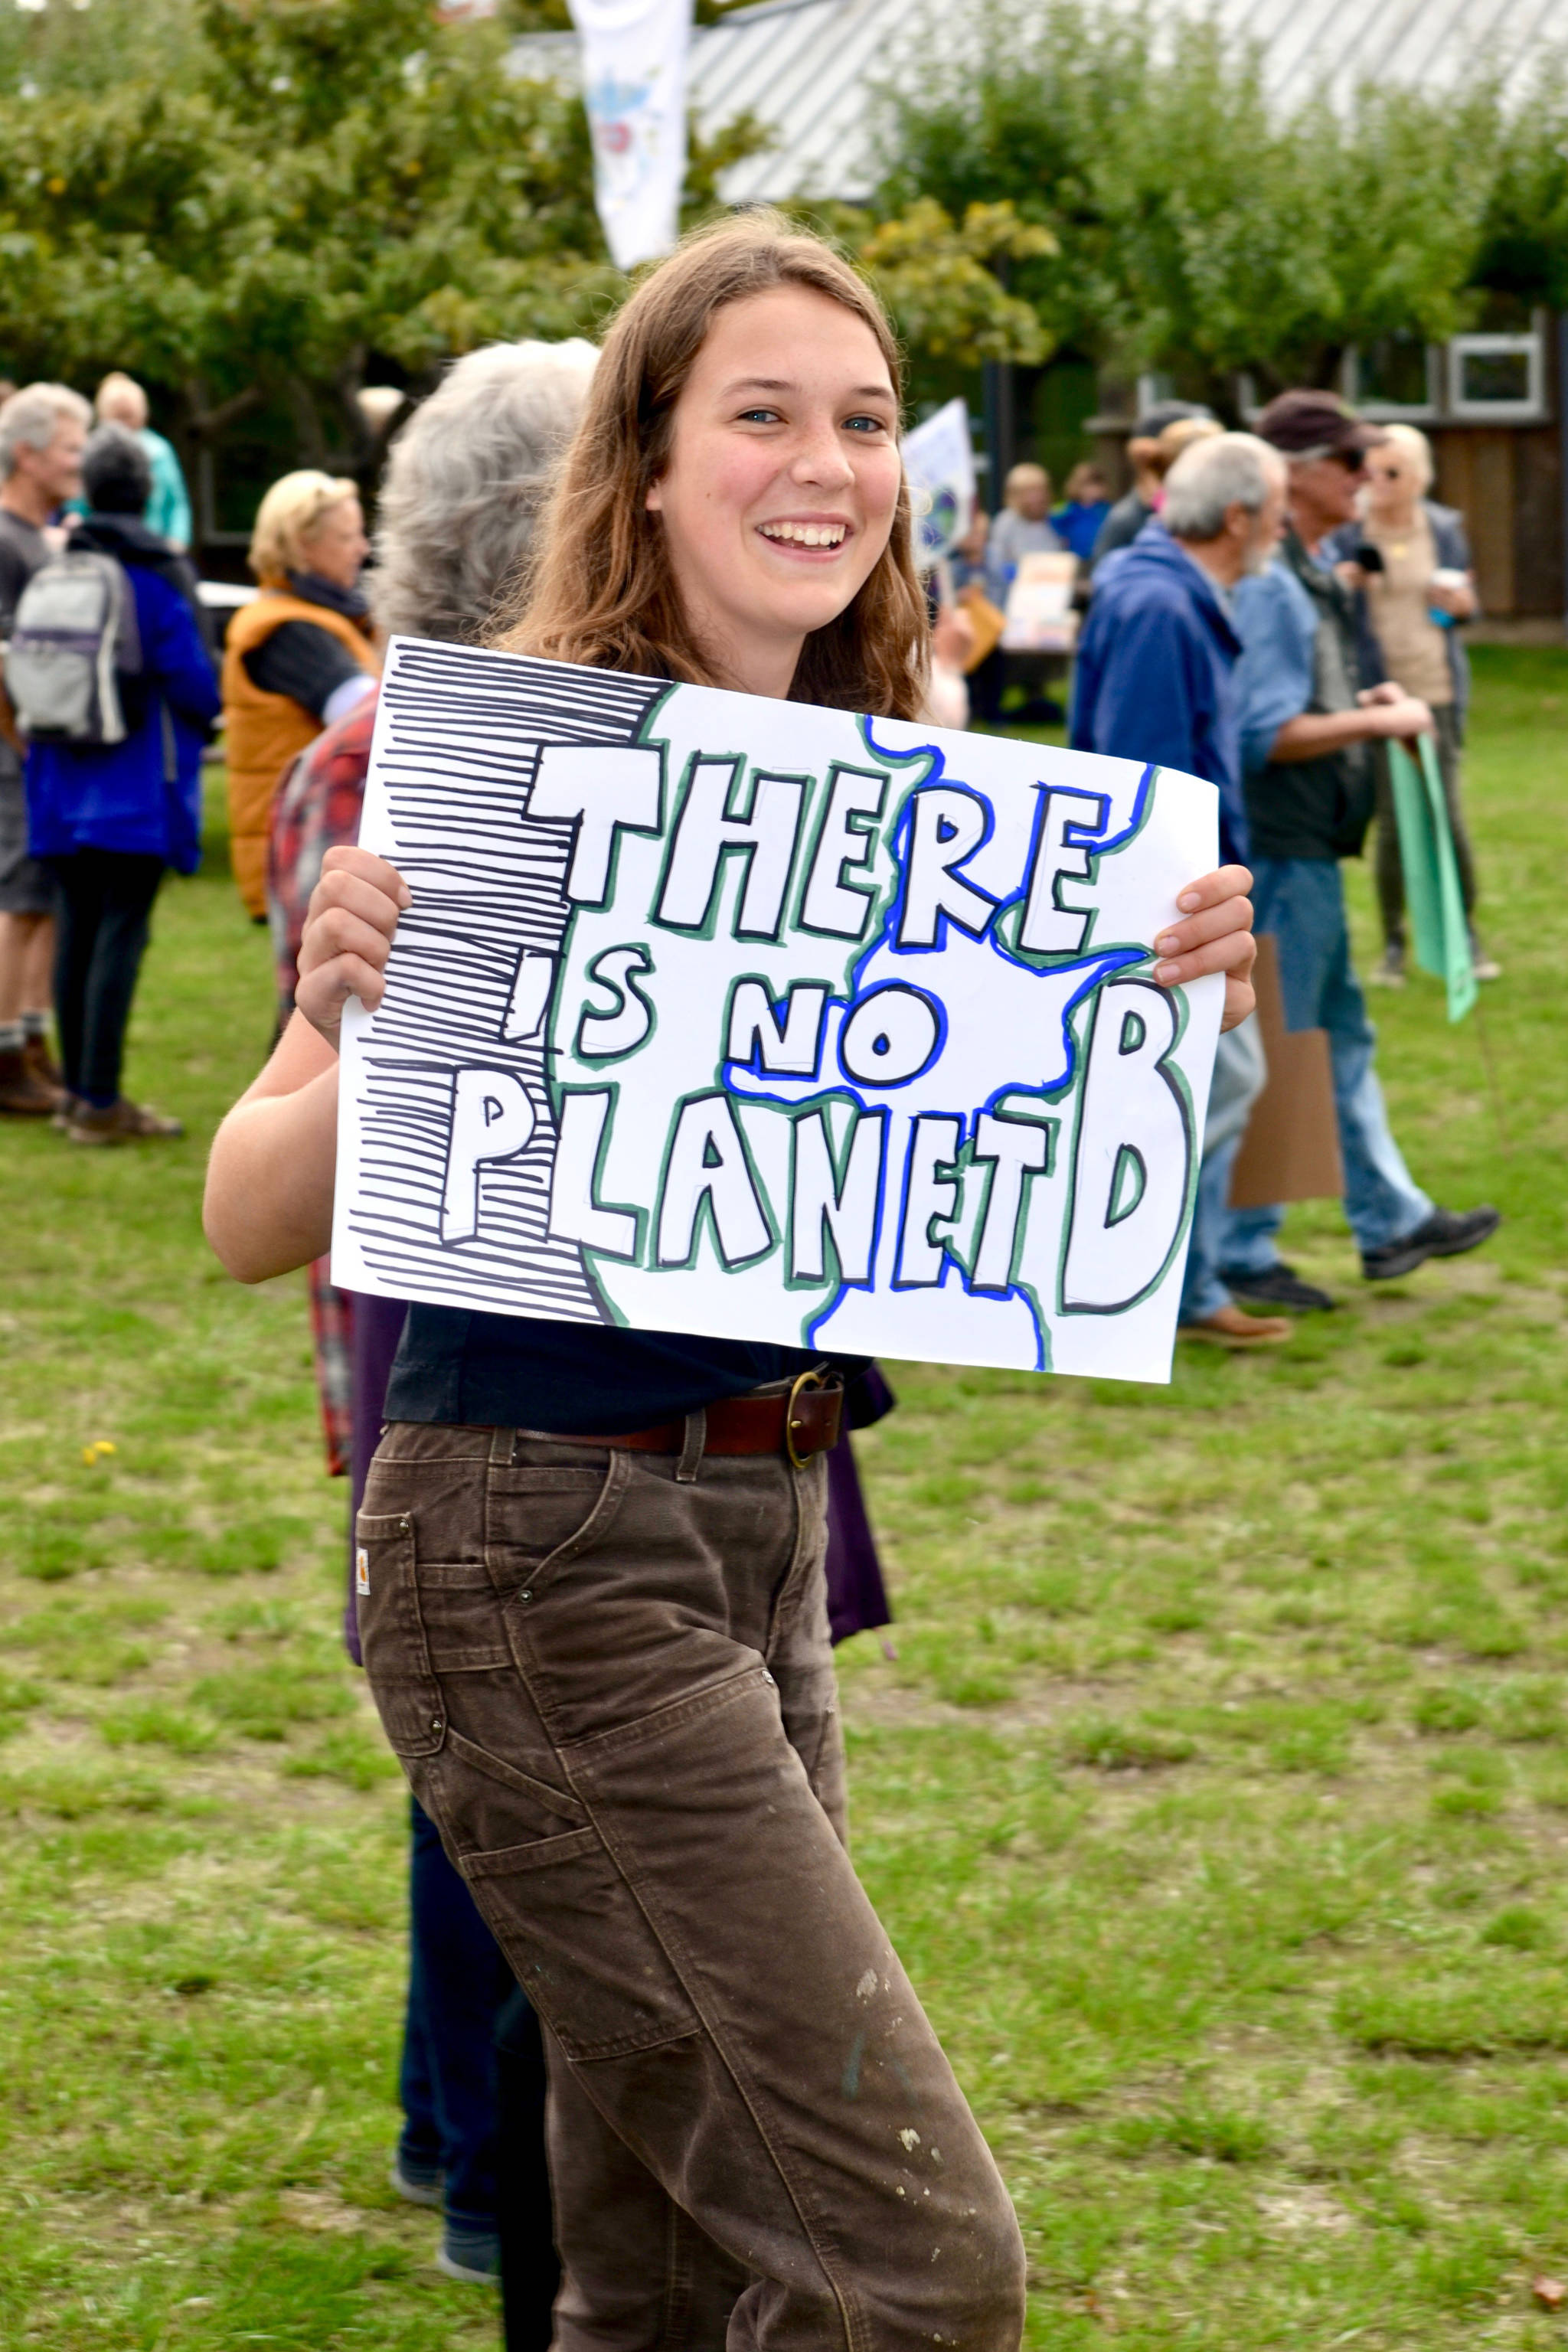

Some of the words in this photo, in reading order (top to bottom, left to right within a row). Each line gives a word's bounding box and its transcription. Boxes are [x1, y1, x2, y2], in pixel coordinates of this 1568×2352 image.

[521, 741, 1110, 955] THERE
[499, 944, 652, 1059] IS
[727, 976, 942, 1087] NO
[439, 1069, 1050, 1295] PLANET
[1060, 976, 1191, 1315] B
